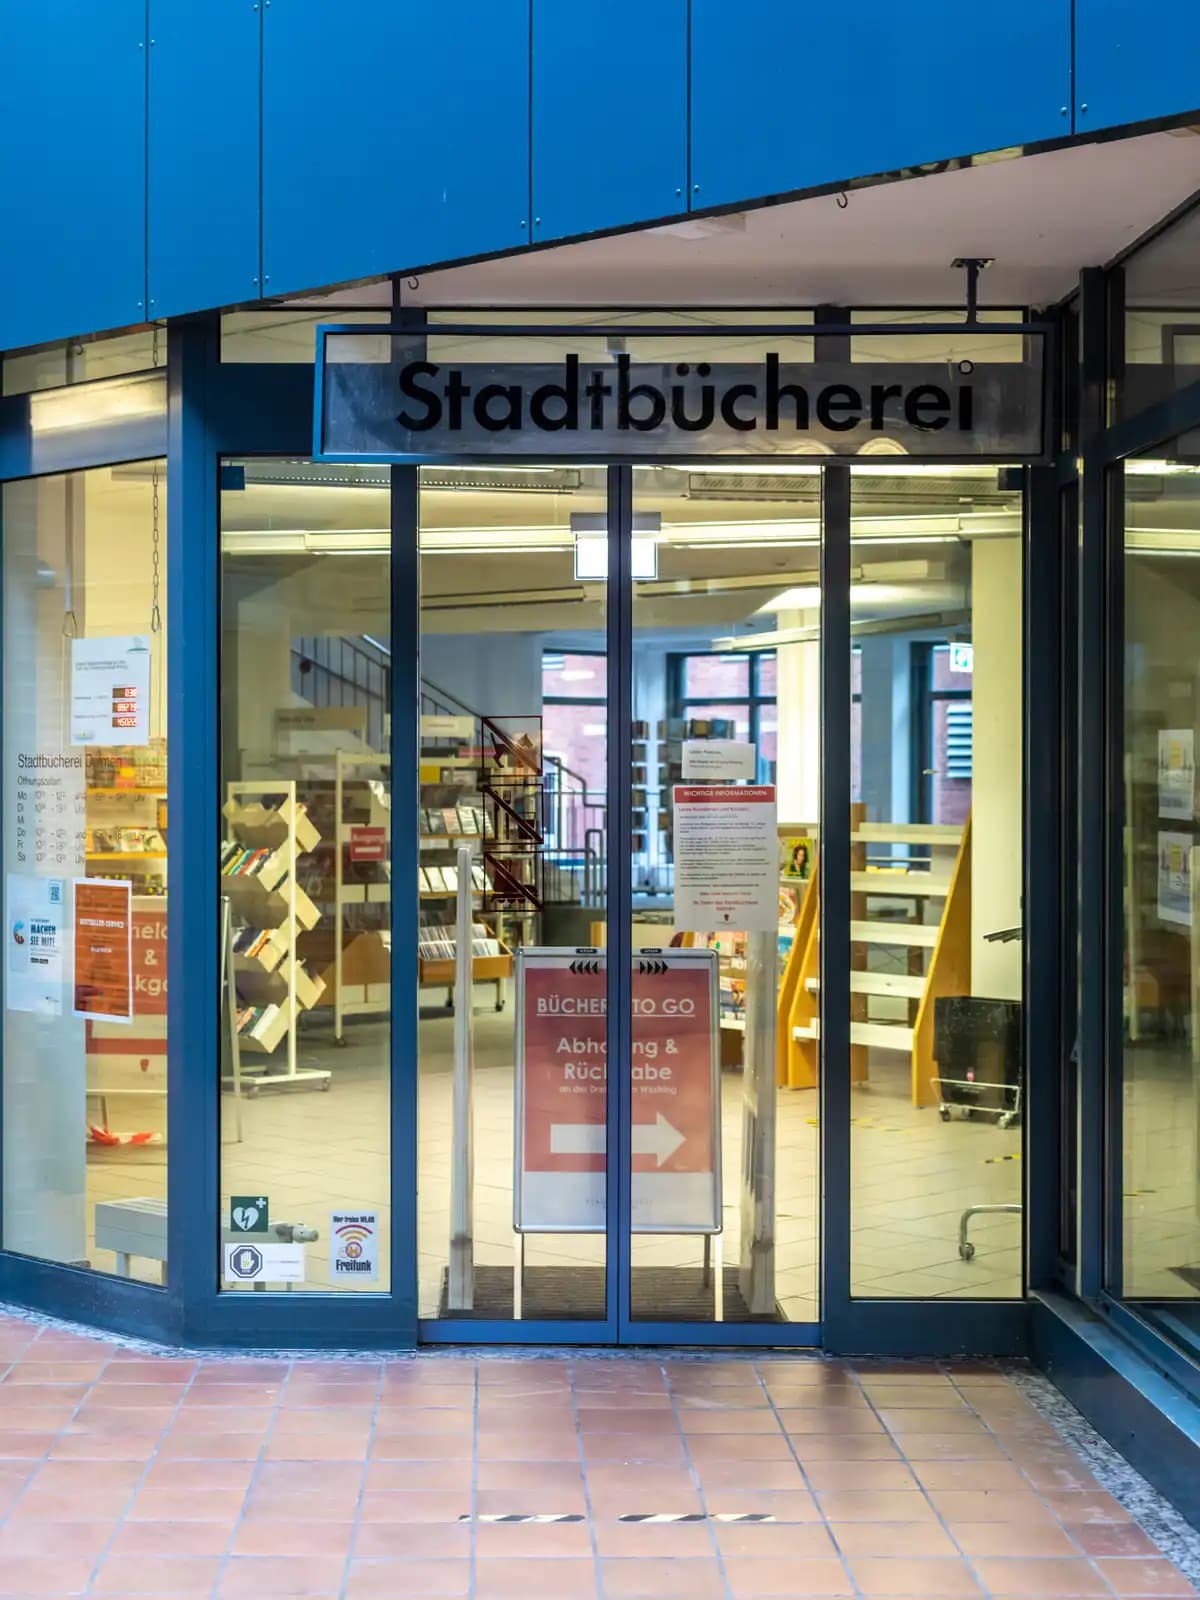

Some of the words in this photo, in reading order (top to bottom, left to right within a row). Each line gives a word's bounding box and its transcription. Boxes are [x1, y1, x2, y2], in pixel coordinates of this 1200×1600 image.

[396, 352, 974, 433] Stadtbücherei
[683, 789, 714, 797] WICHTIGE
[715, 789, 767, 798] INFORMATIONEN
[30, 924, 56, 935] MACHEN
[30, 936, 39, 946] SIE
[144, 948, 158, 966] &
[536, 994, 607, 1014] BÜCHER
[662, 997, 695, 1014] GO
[664, 1038, 679, 1055] &
[360, 1216, 375, 1224] WLAN
[335, 1259, 372, 1272] Freifunk
